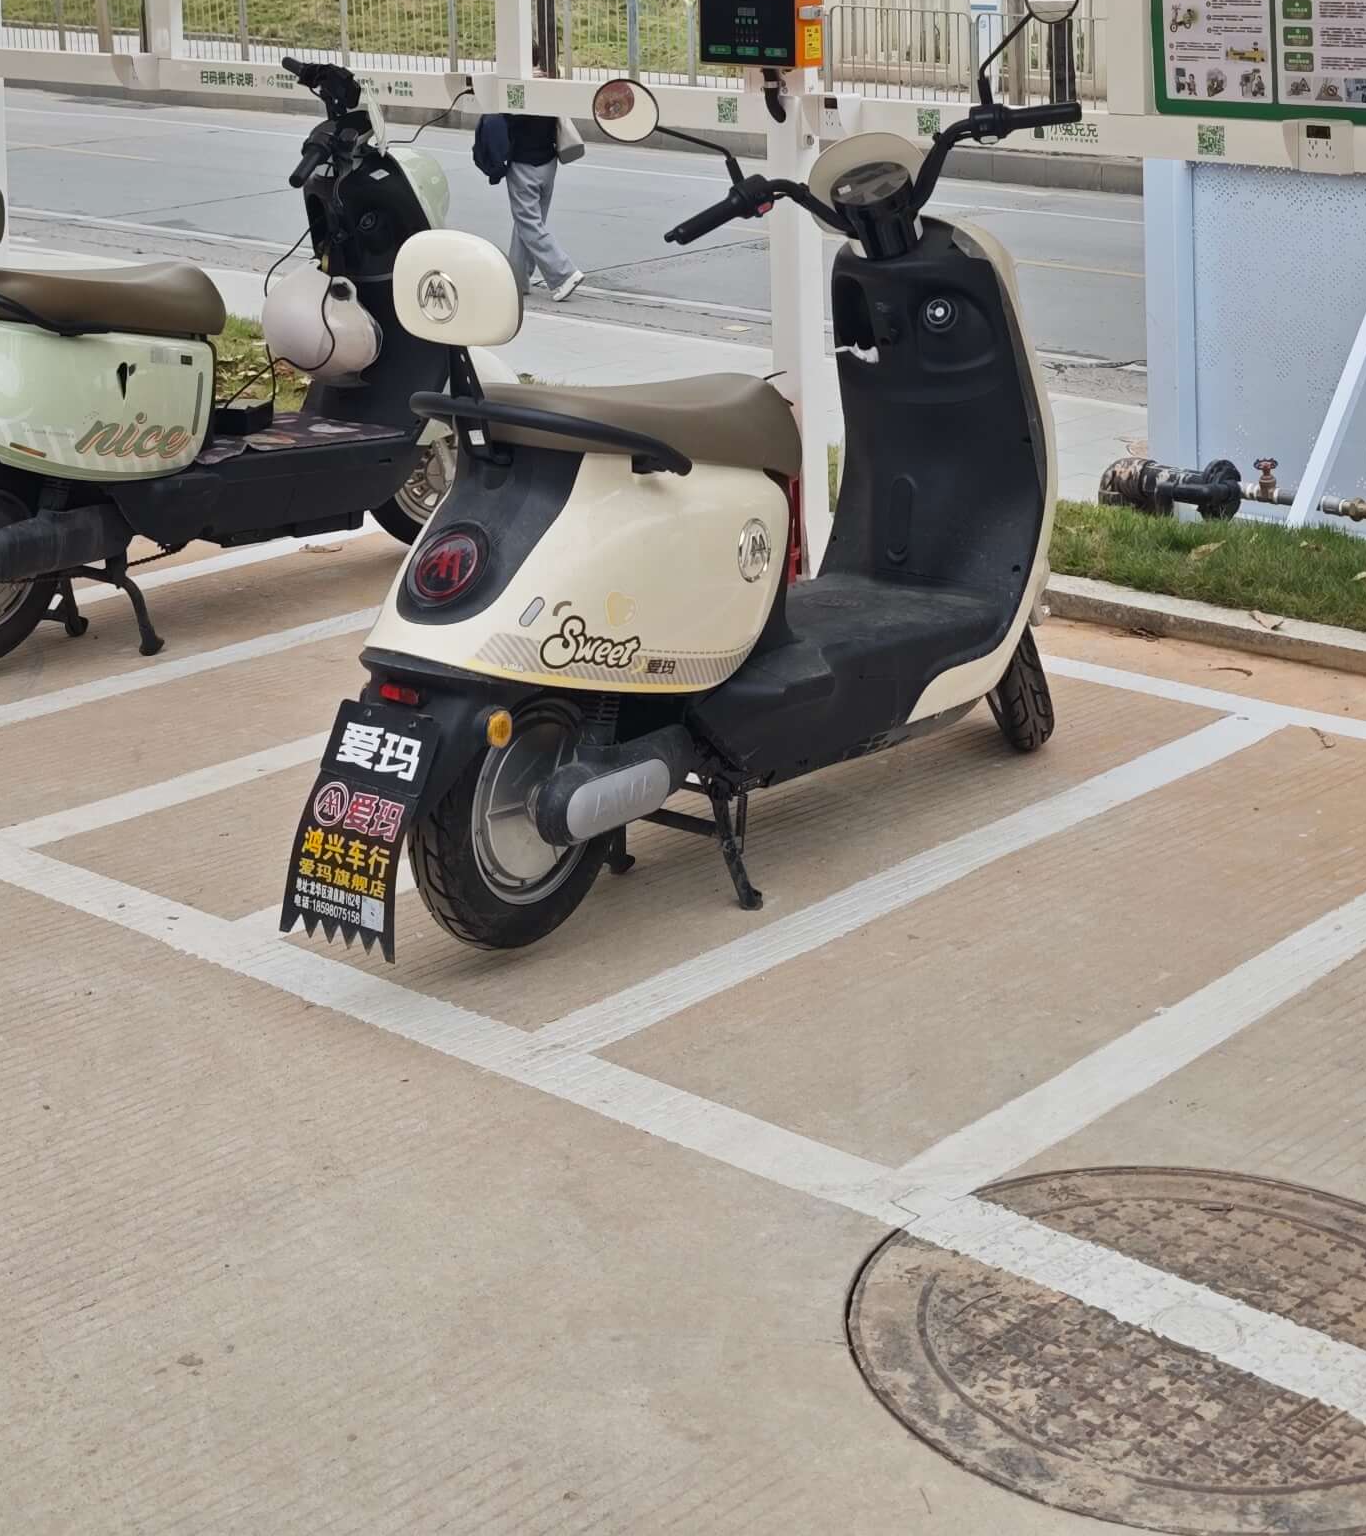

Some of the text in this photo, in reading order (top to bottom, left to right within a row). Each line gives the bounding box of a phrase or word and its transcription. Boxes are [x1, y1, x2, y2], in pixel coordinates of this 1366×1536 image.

[75, 411, 191, 459] nice
[540, 615, 641, 670] Sweet
[645, 659, 677, 675] 爱玛
[336, 722, 422, 782] 爱玛
[343, 791, 405, 843] 爱玛
[301, 825, 391, 879] 鸿兴车行
[299, 857, 387, 900] 爱玛旗舰店
